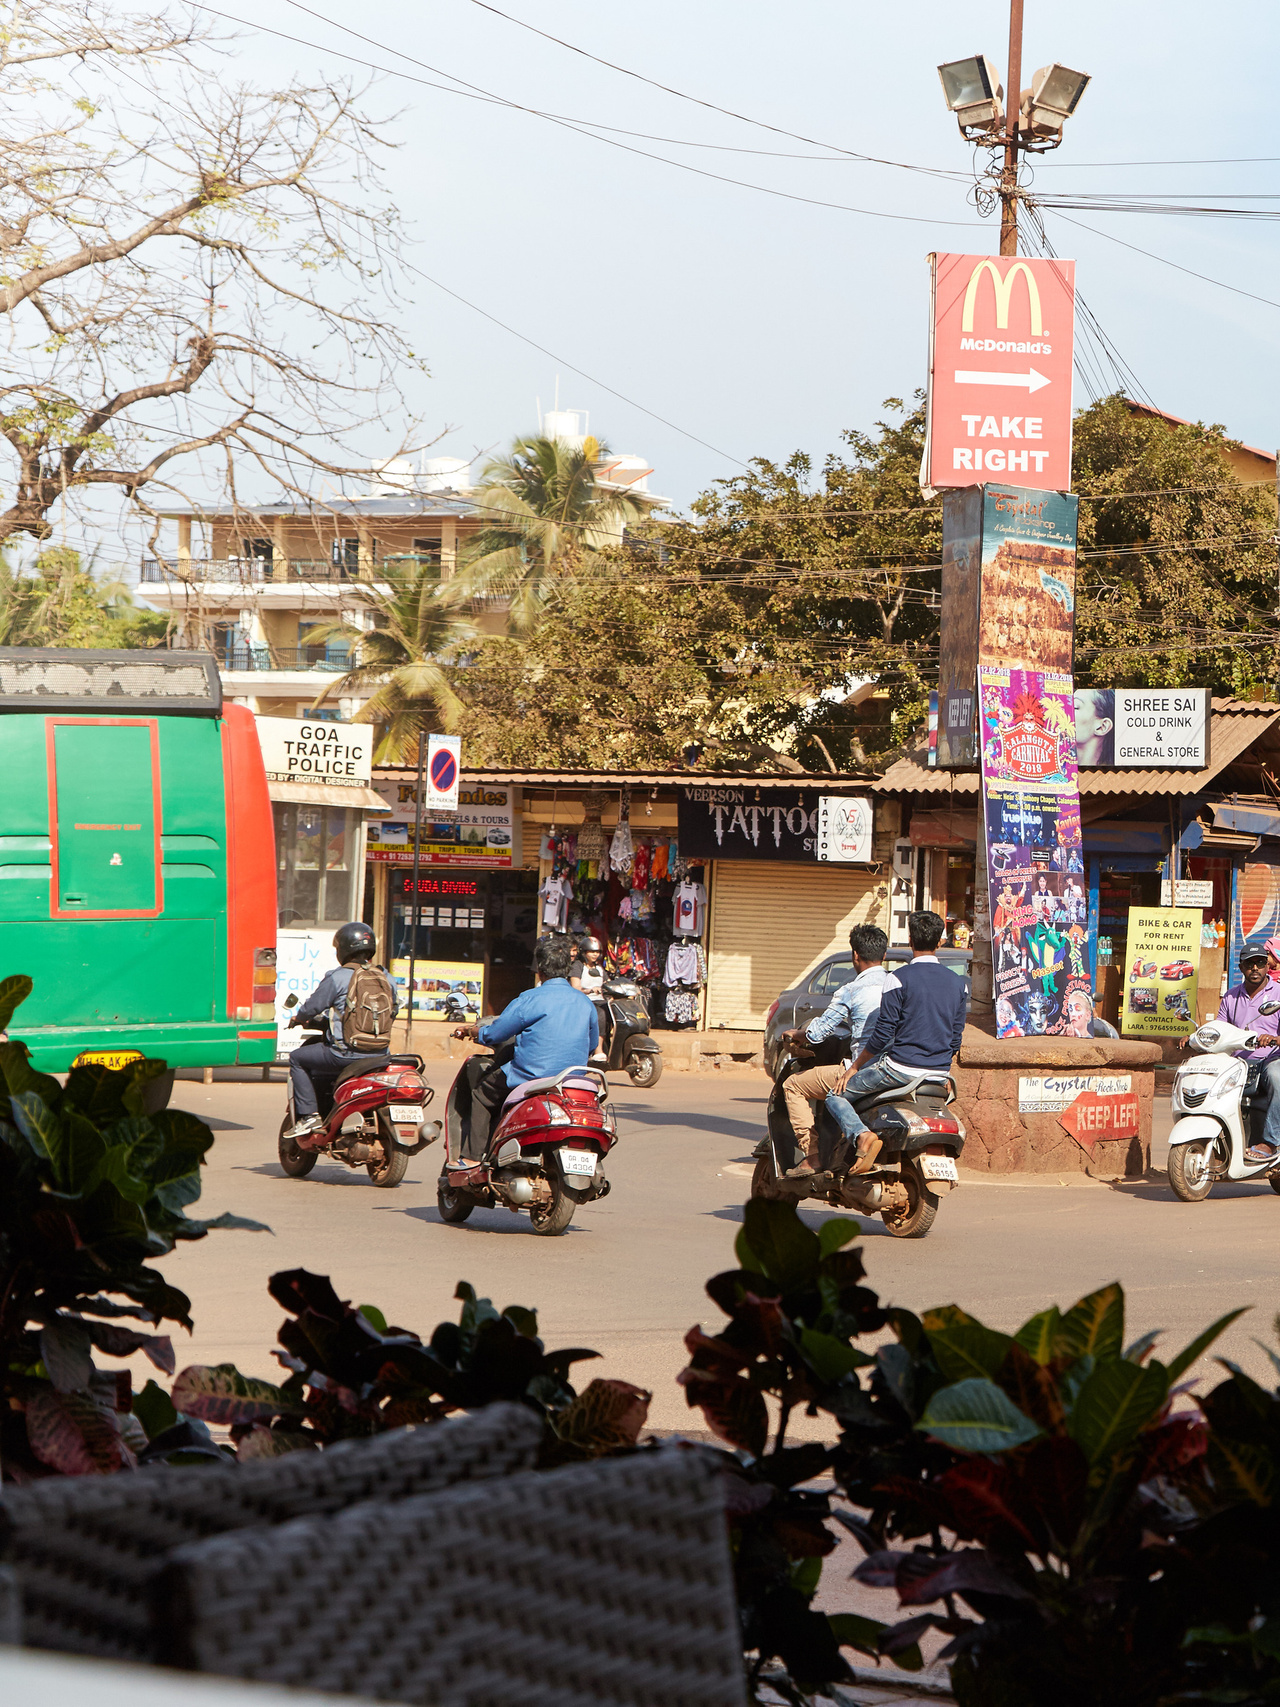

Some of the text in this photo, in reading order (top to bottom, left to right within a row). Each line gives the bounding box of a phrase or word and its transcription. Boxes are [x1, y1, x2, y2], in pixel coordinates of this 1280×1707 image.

[960, 338, 1052, 355] McDonald's
[961, 414, 1043, 439] TAKE
[953, 447, 1050, 472] RIGHT
[1124, 699, 1196, 711] SHREE SAI
[1127, 717, 1192, 727] COLD DRINK
[300, 726, 339, 742] GOA
[1155, 731, 1163, 742] &
[284, 741, 363, 760] TRAFFIC
[1005, 734, 1055, 754] CALANGUTE
[1011, 744, 1051, 763] CARNIVAL
[1120, 747, 1200, 758] GENERAL STORE
[288, 757, 355, 775] POLICE
[1020, 762, 1042, 773] 2018
[277, 773, 290, 781] BY
[294, 774, 325, 785] DIGITAL
[325, 777, 365, 787] DESIGNER
[397, 785, 508, 806] Fendes
[684, 787, 745, 803] VEERSON
[480, 816, 509, 824] TOURS
[1054, 816, 1081, 832] Xavier
[441, 880, 477, 894] DIVING
[1012, 905, 1033, 917] KING
[1012, 915, 1038, 928] MOMO
[1138, 919, 1192, 929] BIKE & CAR
[996, 966, 1022, 982] FANCY
[1032, 961, 1064, 979] Mascot
[277, 971, 321, 991] Fash
[1000, 976, 1027, 992] DRESS
[1025, 1077, 1039, 1087] The
[1095, 1081, 1114, 1093] Rock
[1076, 1103, 1137, 1132] KEEP LEFT
